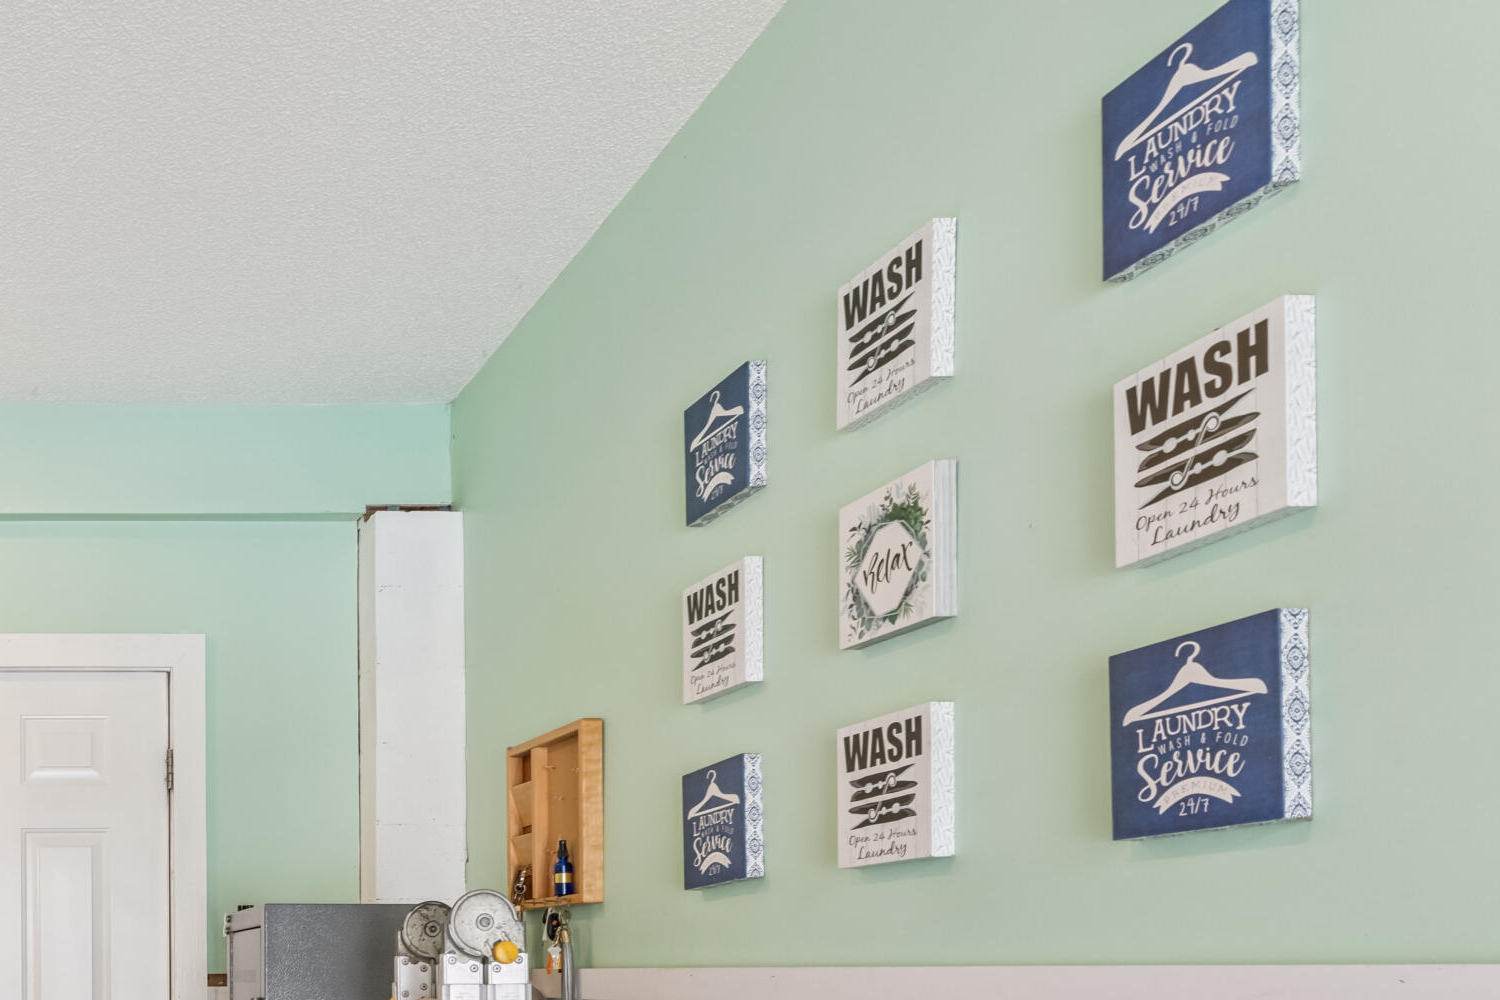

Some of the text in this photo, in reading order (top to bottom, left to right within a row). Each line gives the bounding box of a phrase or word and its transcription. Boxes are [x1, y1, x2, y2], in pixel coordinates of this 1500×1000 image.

[1128, 80, 1241, 181] LAUNDRY
[1149, 142, 1182, 174] WASH
[1206, 115, 1239, 136] FOLD
[1128, 136, 1236, 230] Service
[1169, 196, 1199, 226] 24/7
[843, 239, 923, 331] WASH
[847, 384, 868, 404] Open
[855, 377, 905, 415] Laundry
[1125, 318, 1269, 436] WASH
[695, 421, 738, 468] LAUNDRY
[695, 453, 737, 498] Service
[1135, 477, 1260, 531] Open 24 Hours
[1151, 501, 1241, 546] Laundry
[863, 541, 913, 594] Relax
[687, 569, 739, 626] WASH
[844, 715, 922, 773] WASH
[1136, 702, 1251, 753] LAUNDRY
[1158, 731, 1249, 756] WASH & FOLD
[1137, 747, 1245, 802] Service
[692, 808, 735, 837] LAUNDRY
[1179, 797, 1209, 816] 24/7
[693, 835, 733, 867] Service
[849, 828, 917, 848] Open 24 Hours
[858, 841, 907, 860] Laundry
